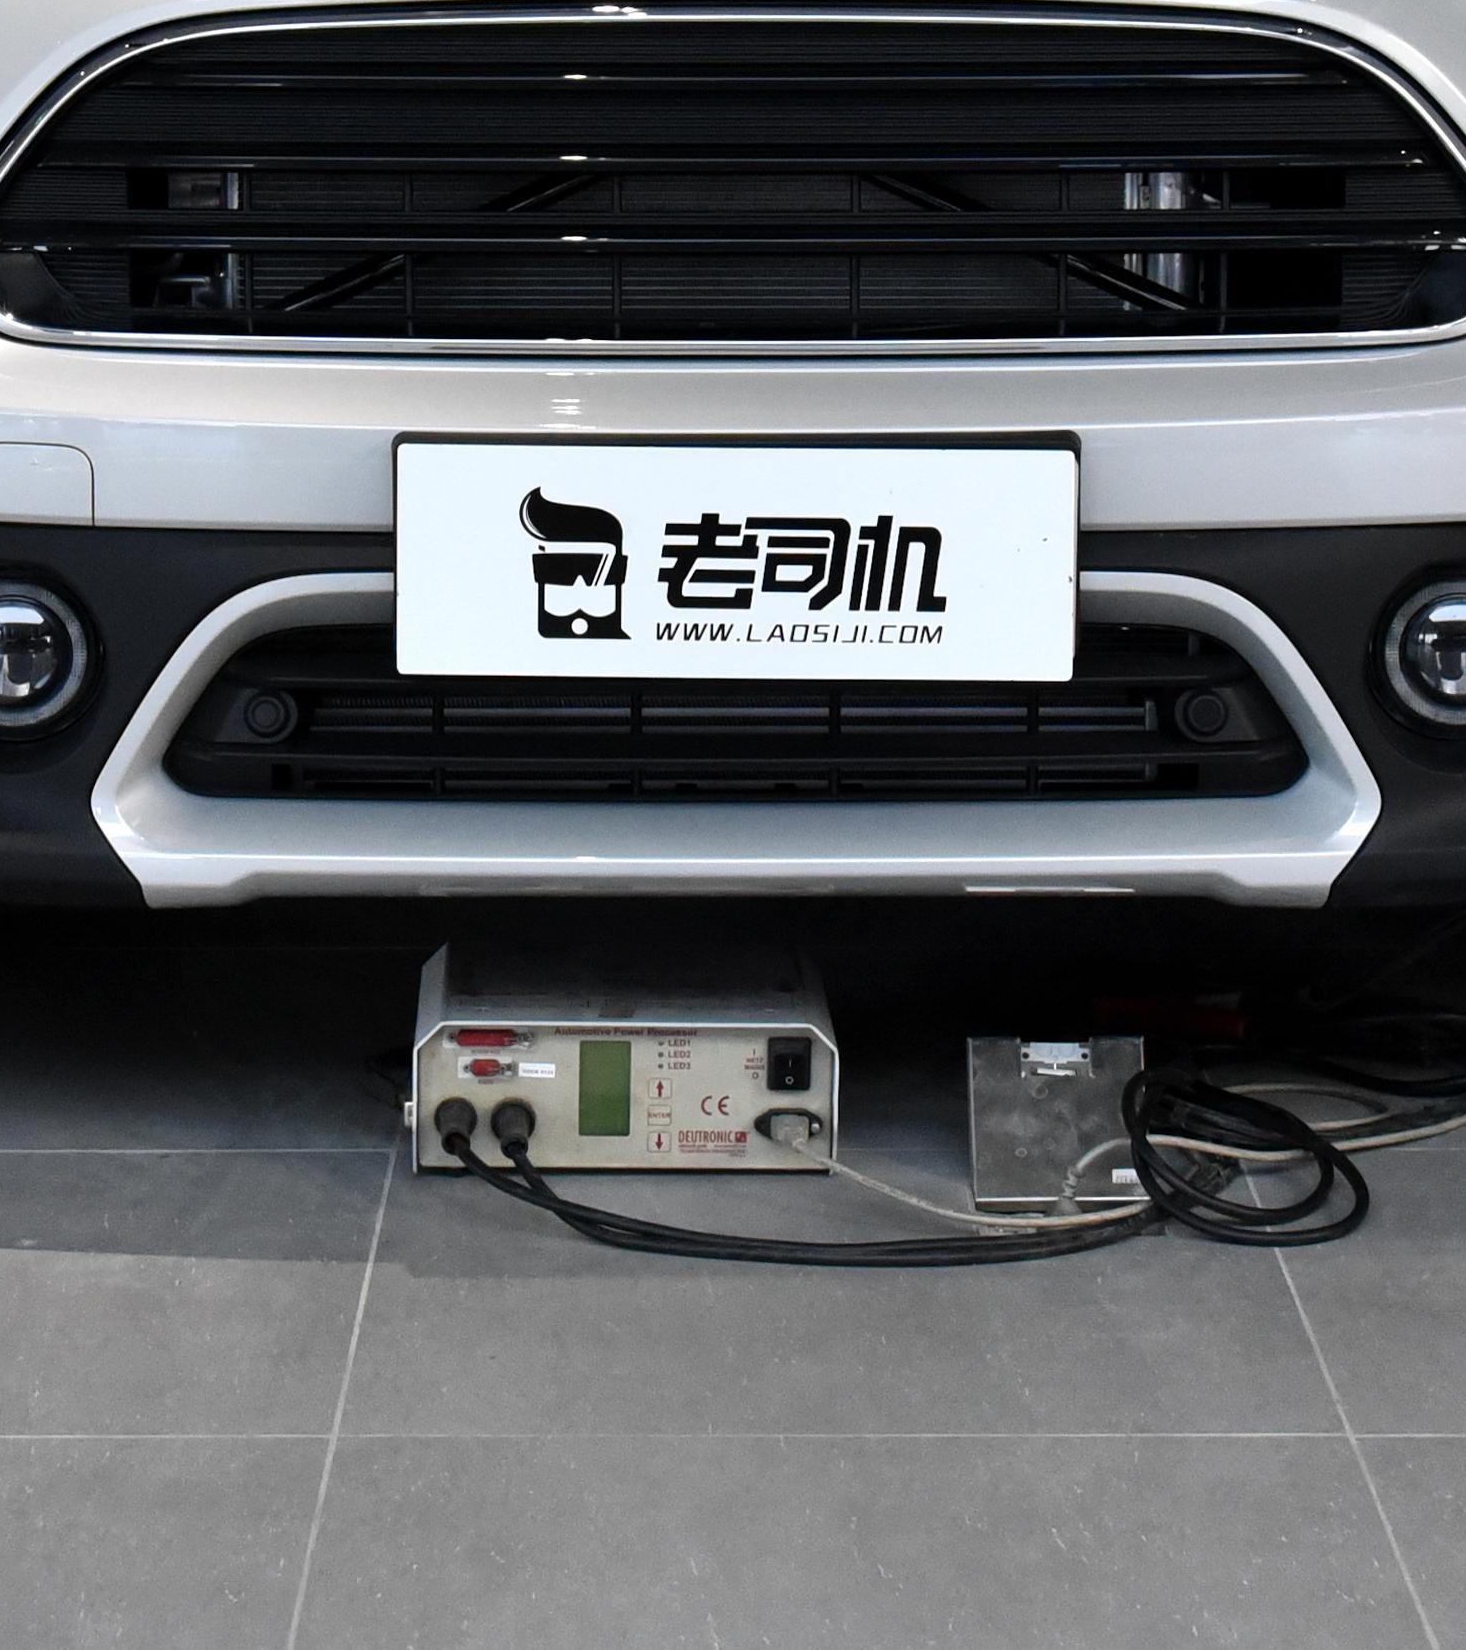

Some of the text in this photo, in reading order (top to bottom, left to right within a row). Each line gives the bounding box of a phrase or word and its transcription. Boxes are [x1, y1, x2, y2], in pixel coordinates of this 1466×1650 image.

[658, 513, 946, 612] 老司机
[657, 623, 942, 643] WWW.LAOSIJI.COM
[554, 1026, 612, 1037] Automotive
[614, 1026, 644, 1037] Power
[678, 1130, 733, 1144] DEUTRONIC
